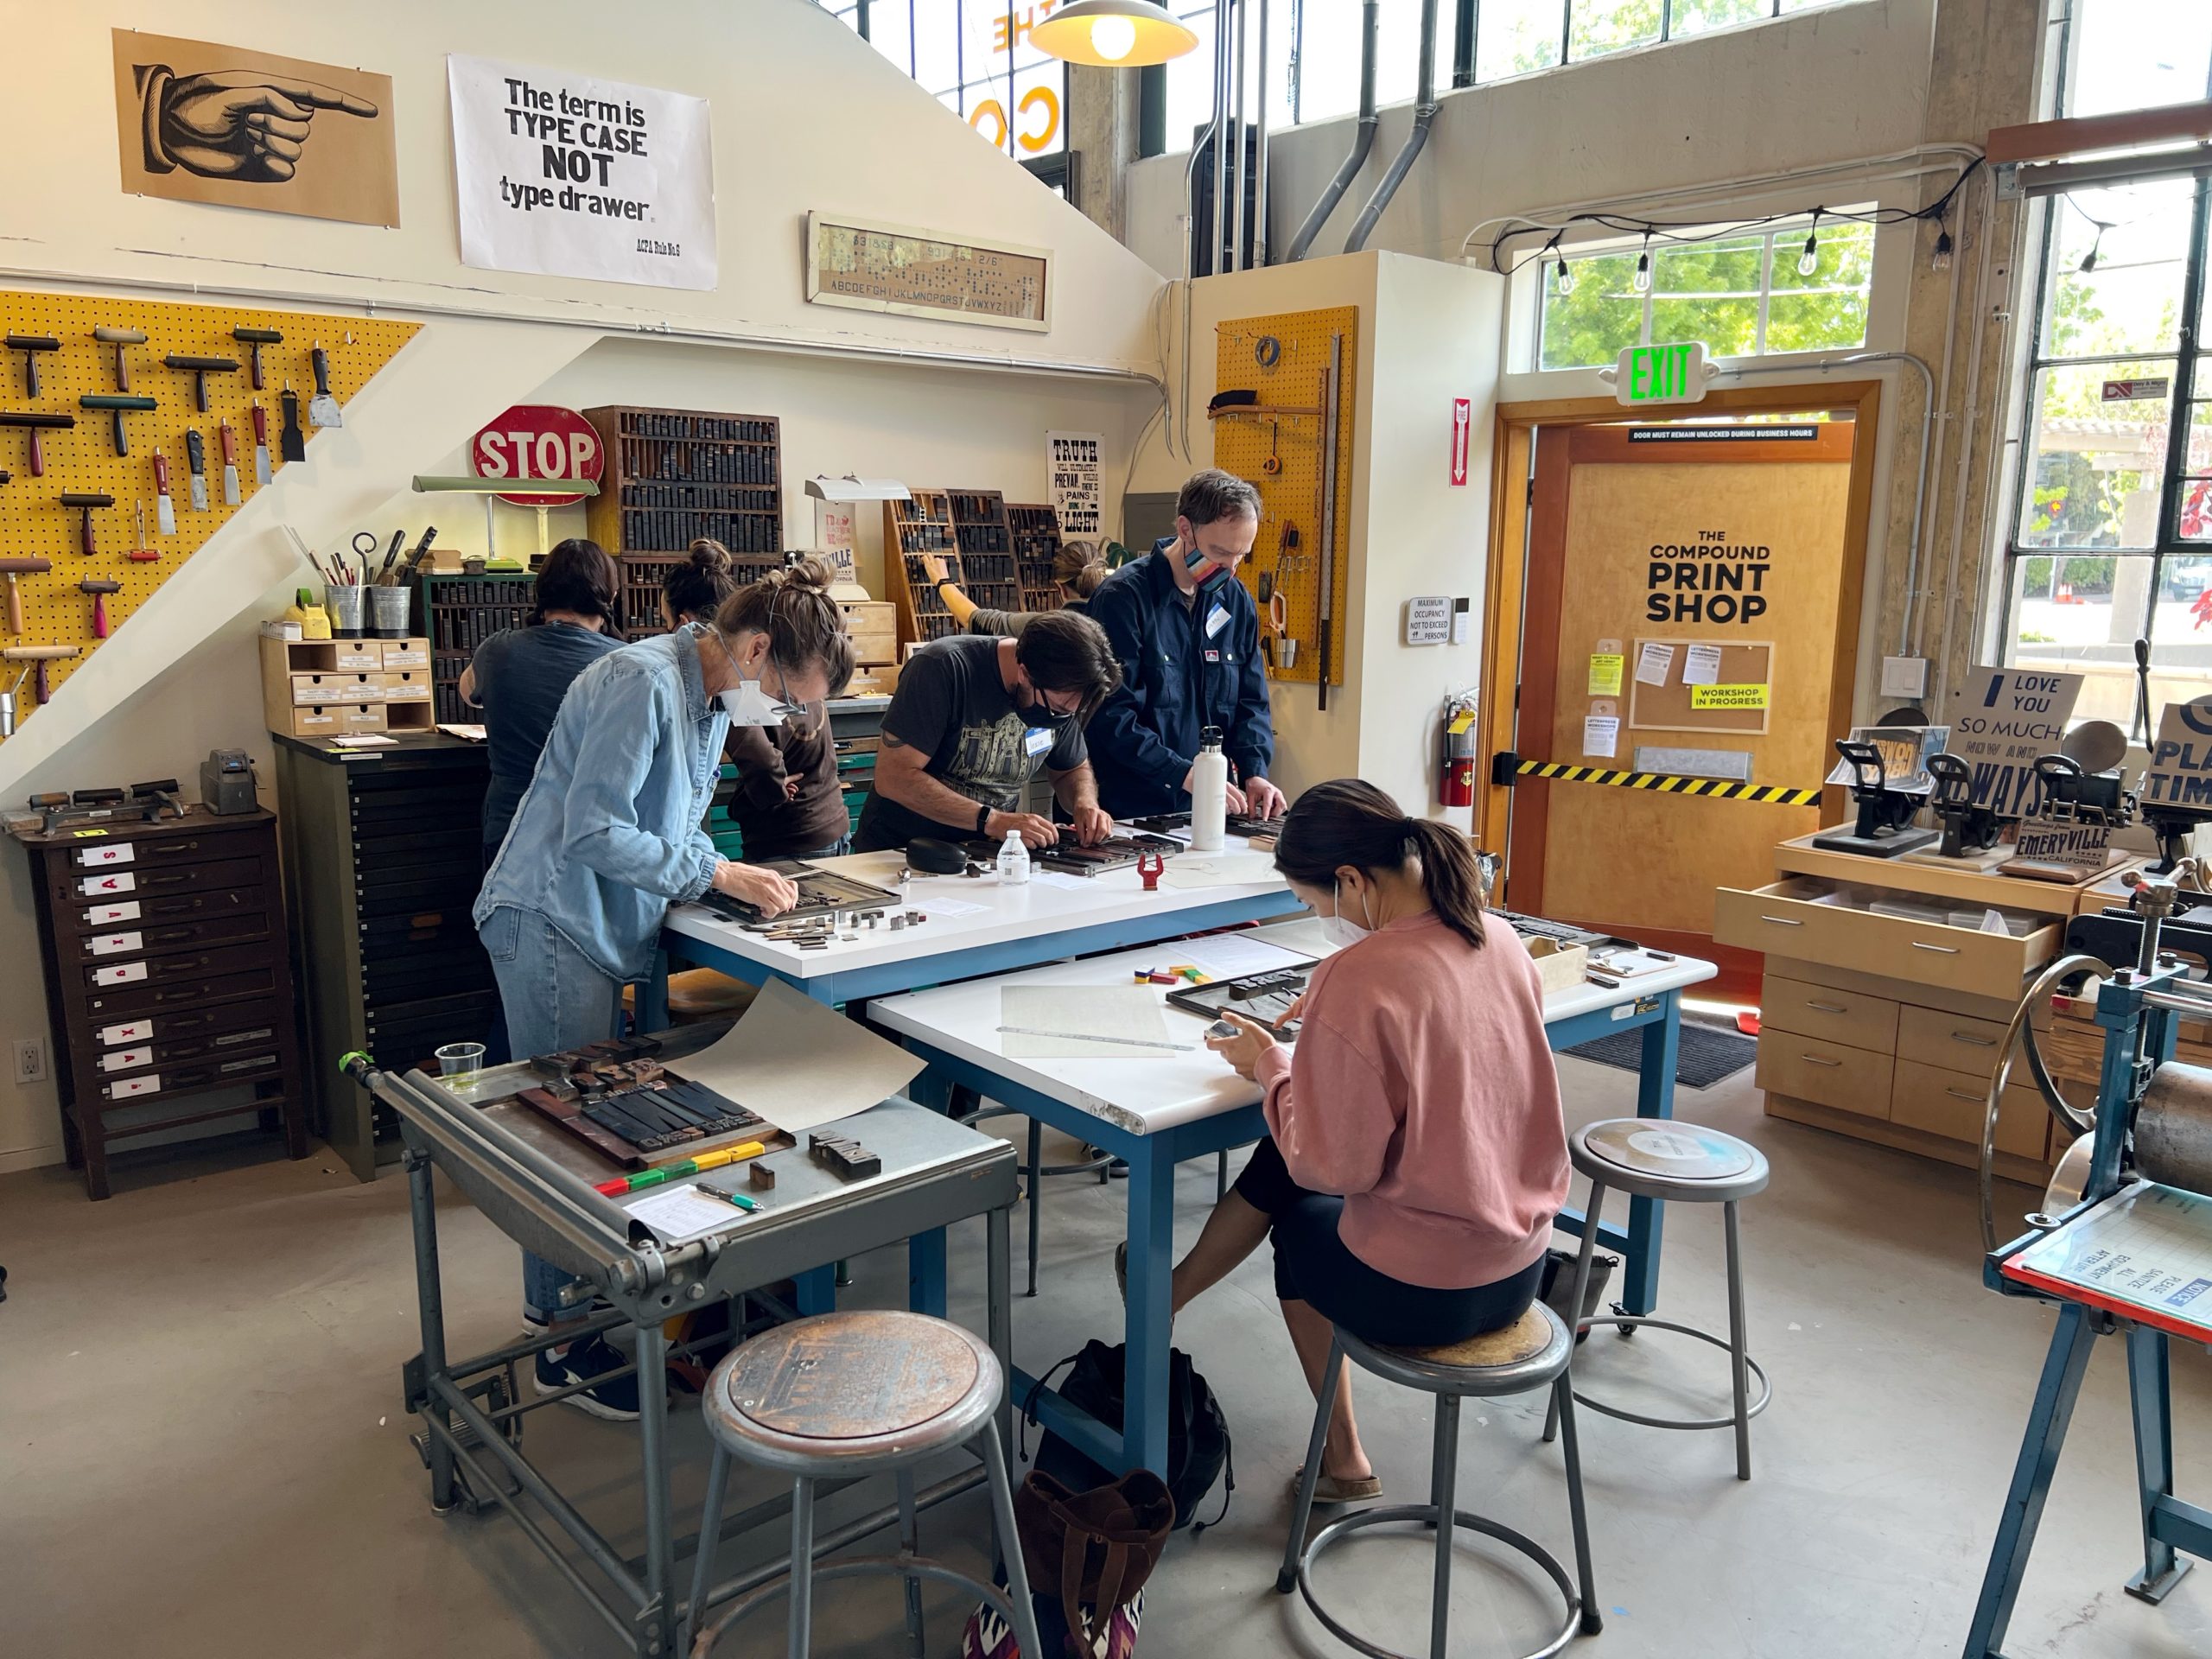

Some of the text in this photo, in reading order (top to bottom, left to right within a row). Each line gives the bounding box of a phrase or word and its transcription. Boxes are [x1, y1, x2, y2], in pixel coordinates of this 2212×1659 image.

[504, 78, 645, 128] The term is
[504, 108, 647, 157] TYPE CASE
[543, 144, 614, 188] NOT
[499, 175, 554, 211] type
[636, 238, 653, 254] ACPA
[654, 240, 667, 256] Rule
[1630, 344, 1693, 401] EXIT
[1789, 429, 1813, 437] HOURS
[479, 430, 596, 480] STOP
[1053, 439, 1097, 462] TRUTH
[1065, 491, 1090, 500] PAINS
[1065, 511, 1099, 533] LIGHT
[1698, 531, 1726, 541] THE
[1649, 544, 1770, 560] COMPOUND
[1648, 562, 1770, 591] PRINT
[1414, 609, 1445, 619] OCCUPANCY
[1646, 593, 1767, 624] SHOP
[1409, 621, 1421, 630] NOT
[1429, 620, 1448, 629] EXCEED
[1424, 632, 1447, 640] PERSONS
[1700, 688, 1759, 697] WORKSHOP
[1983, 674, 2062, 708] I LOVE
[1695, 697, 1764, 706] IN PROGRESS
[2014, 696, 2050, 713] YOU
[1958, 717, 2062, 741] SO MUCH
[1966, 741, 2038, 760] NOW AND
[2015, 827, 2111, 856] EMERYVILLE
[2048, 855, 2101, 867] CALIFORNIA
[101, 878, 118, 889] A
[121, 1027, 135, 1037] X
[2087, 1249, 2111, 1265] AFTER
[2088, 1254, 2132, 1280] EQUIPMENT
[2116, 1267, 2137, 1278] ALL
[2127, 1268, 2164, 1289] SANITIZE
[2149, 1275, 2183, 1294] PLEASE
[2171, 1281, 2209, 1304] NOTICE
